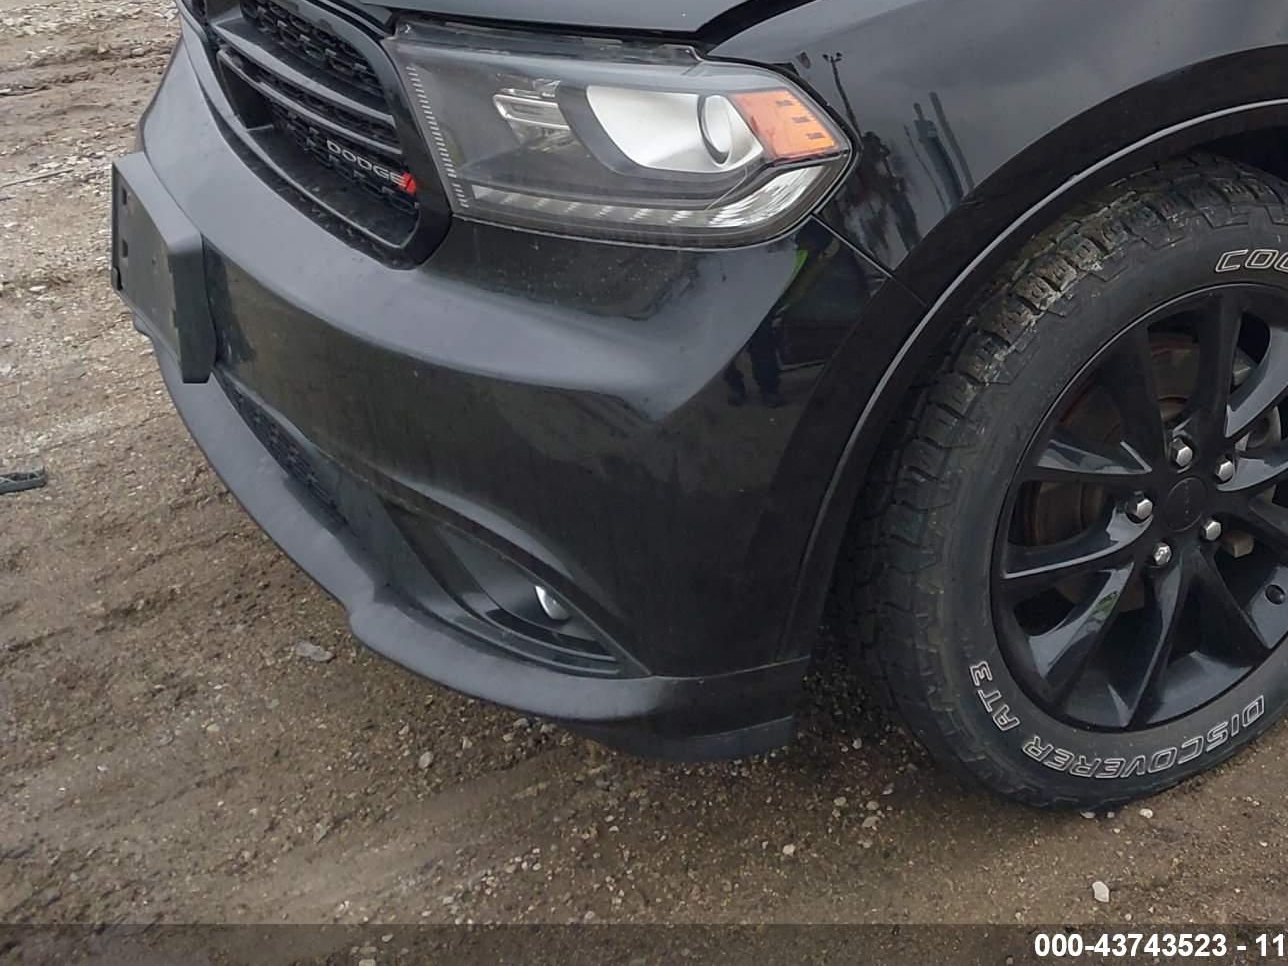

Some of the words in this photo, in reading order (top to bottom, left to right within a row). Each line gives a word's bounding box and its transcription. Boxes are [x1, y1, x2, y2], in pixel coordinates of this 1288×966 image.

[326, 139, 407, 189] DODGE
[969, 660, 1022, 732] AT3
[1021, 694, 1266, 780] DISCOVERER
